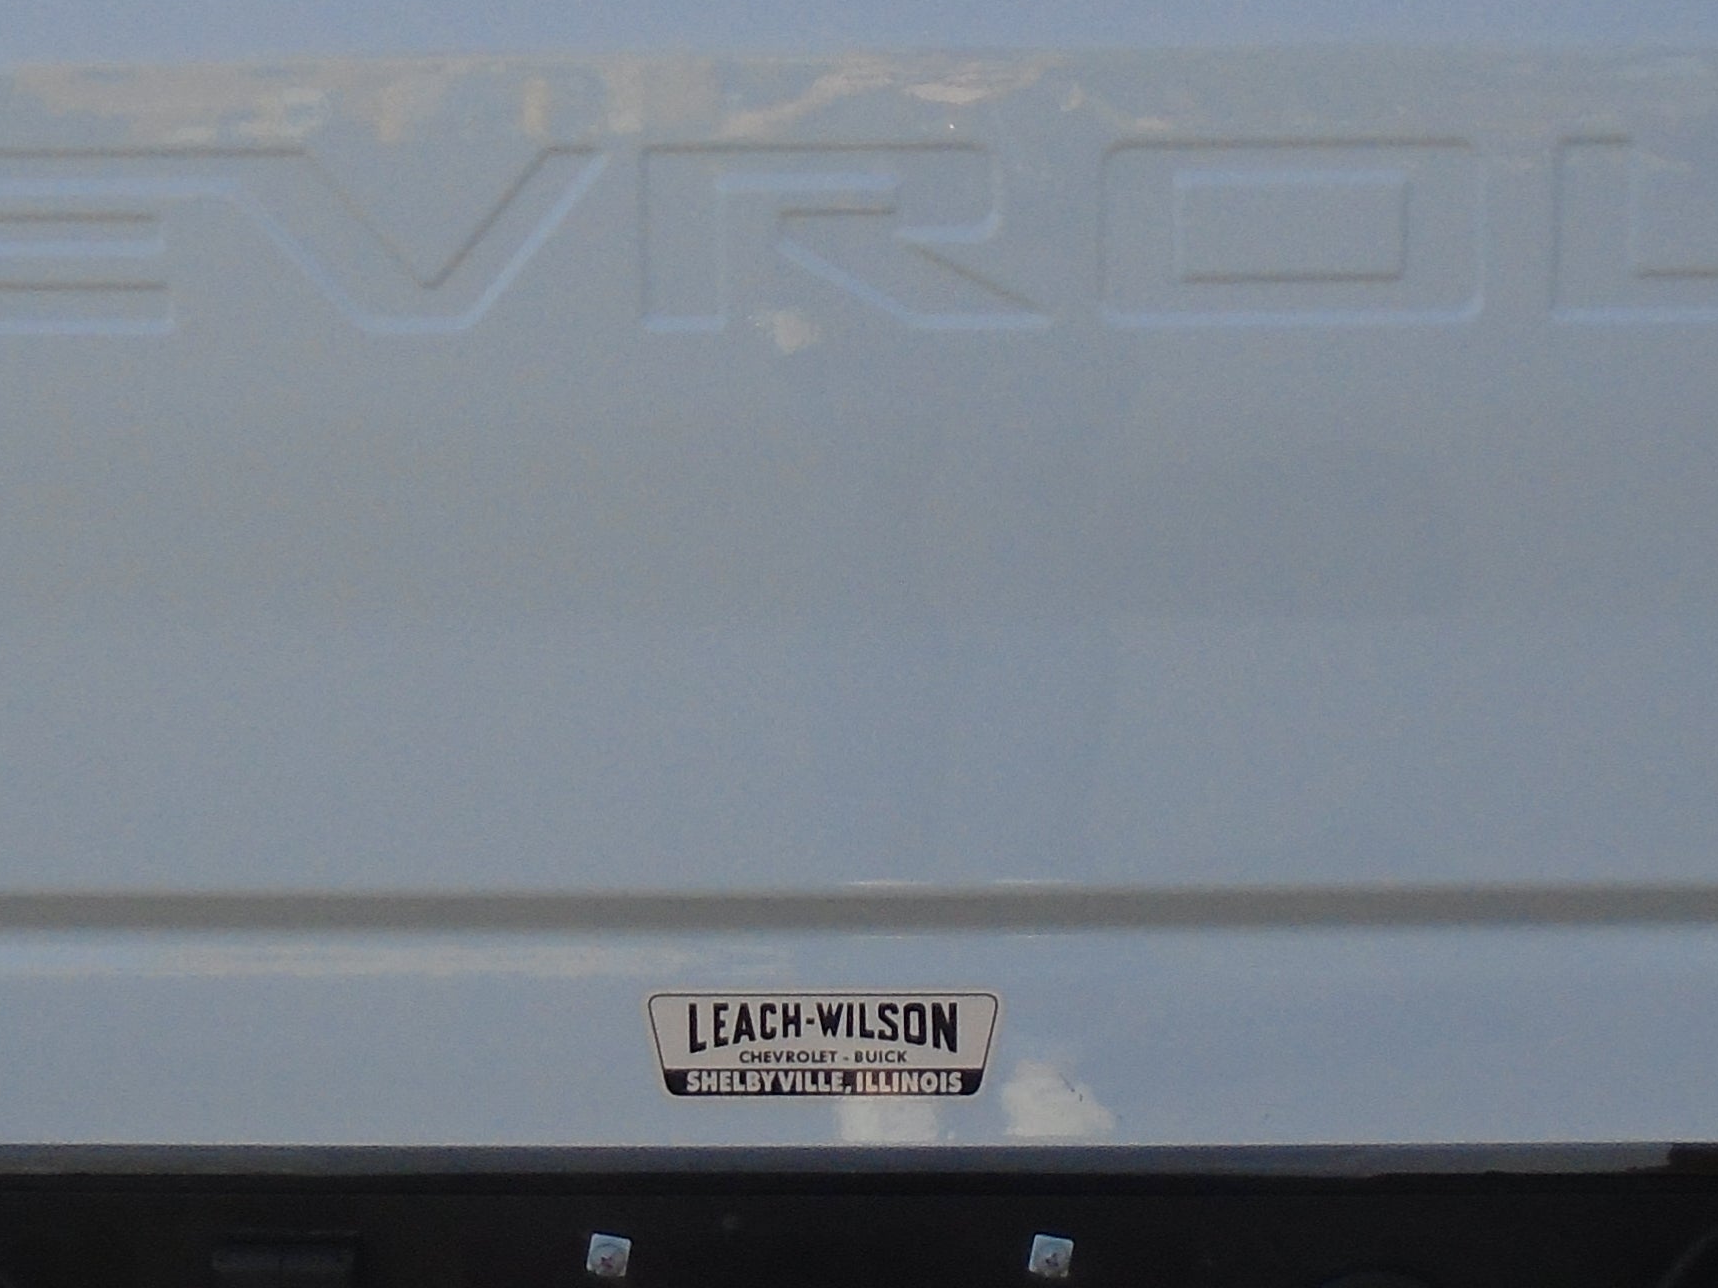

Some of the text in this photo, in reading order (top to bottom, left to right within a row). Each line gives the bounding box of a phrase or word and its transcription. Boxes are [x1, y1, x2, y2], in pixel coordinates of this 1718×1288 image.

[688, 1001, 959, 1054] LEACH-WILSON
[738, 1049, 838, 1065] CHEVROLET
[854, 1049, 909, 1065] BUICK
[685, 1069, 963, 1095] SHELBYVILLE, ILLINOIS
